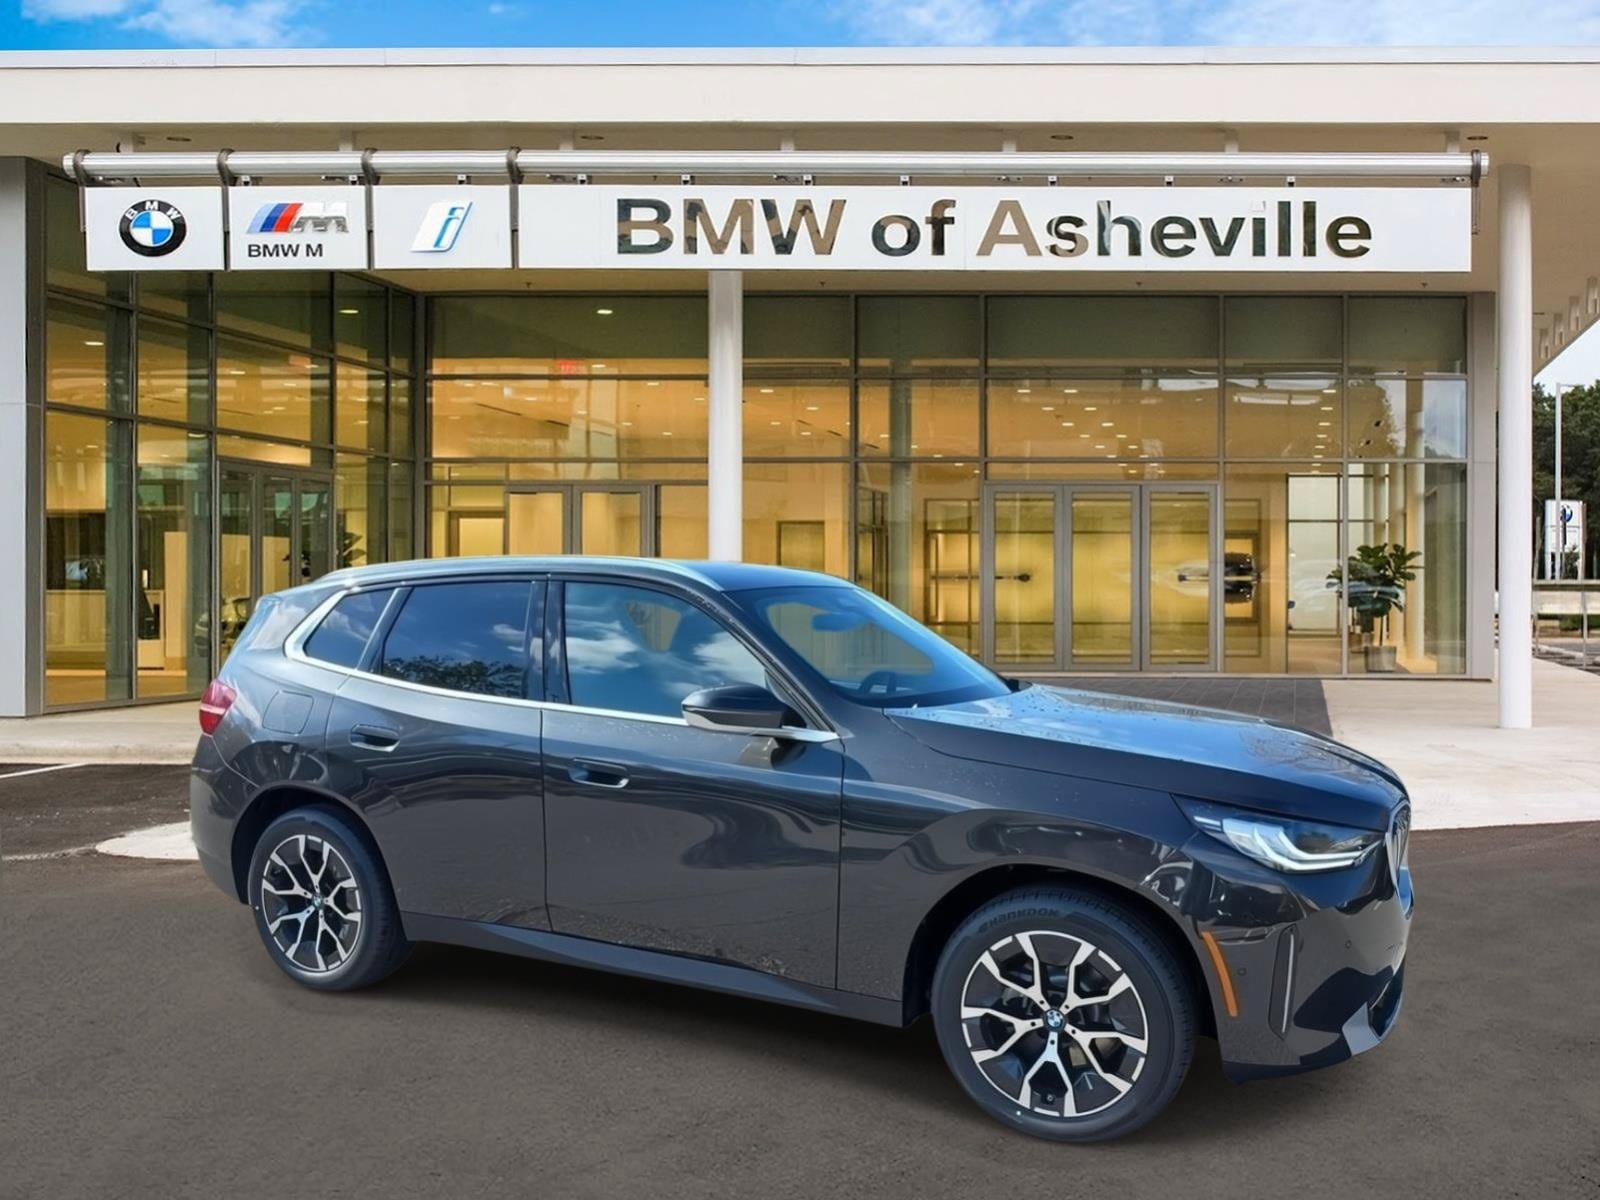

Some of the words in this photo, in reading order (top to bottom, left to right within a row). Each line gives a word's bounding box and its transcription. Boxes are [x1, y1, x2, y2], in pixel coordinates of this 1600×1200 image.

[125, 201, 181, 220] BMW
[617, 198, 847, 256] BMW
[871, 199, 957, 257] of
[976, 199, 1373, 258] Asheville
[247, 244, 300, 258] BMW
[305, 243, 323, 258] M
